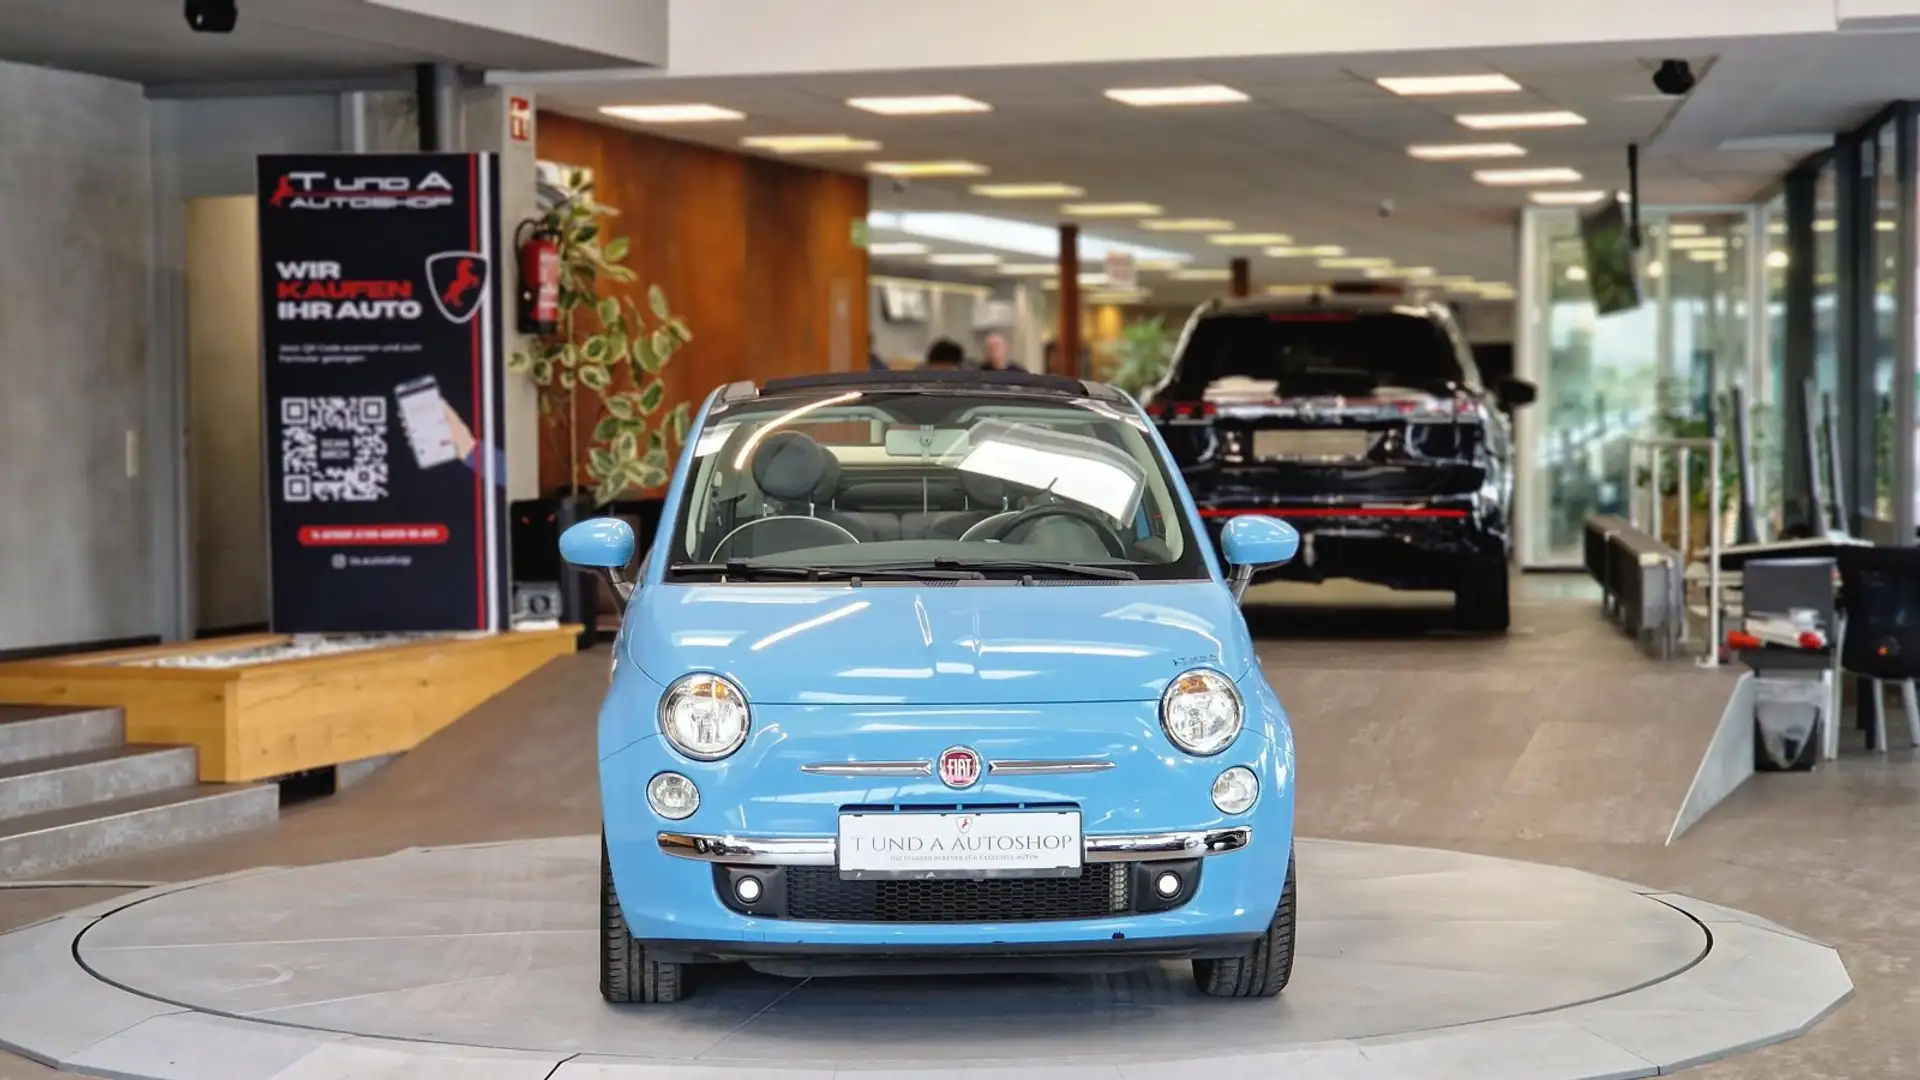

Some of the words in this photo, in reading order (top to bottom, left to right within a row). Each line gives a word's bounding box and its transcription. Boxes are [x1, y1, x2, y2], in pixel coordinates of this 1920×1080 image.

[288, 171, 326, 191] T
[416, 171, 453, 191] A
[289, 196, 454, 210] AUTOSHOP
[276, 261, 341, 280] WIR
[275, 280, 413, 299] KAUFEN
[277, 301, 334, 320] IHR
[335, 301, 422, 320] AUTO
[947, 758, 972, 777] FIAT
[851, 836, 867, 851] T
[872, 836, 923, 852] UND
[930, 835, 944, 851] A
[951, 834, 1072, 851] AUTOSHOP
